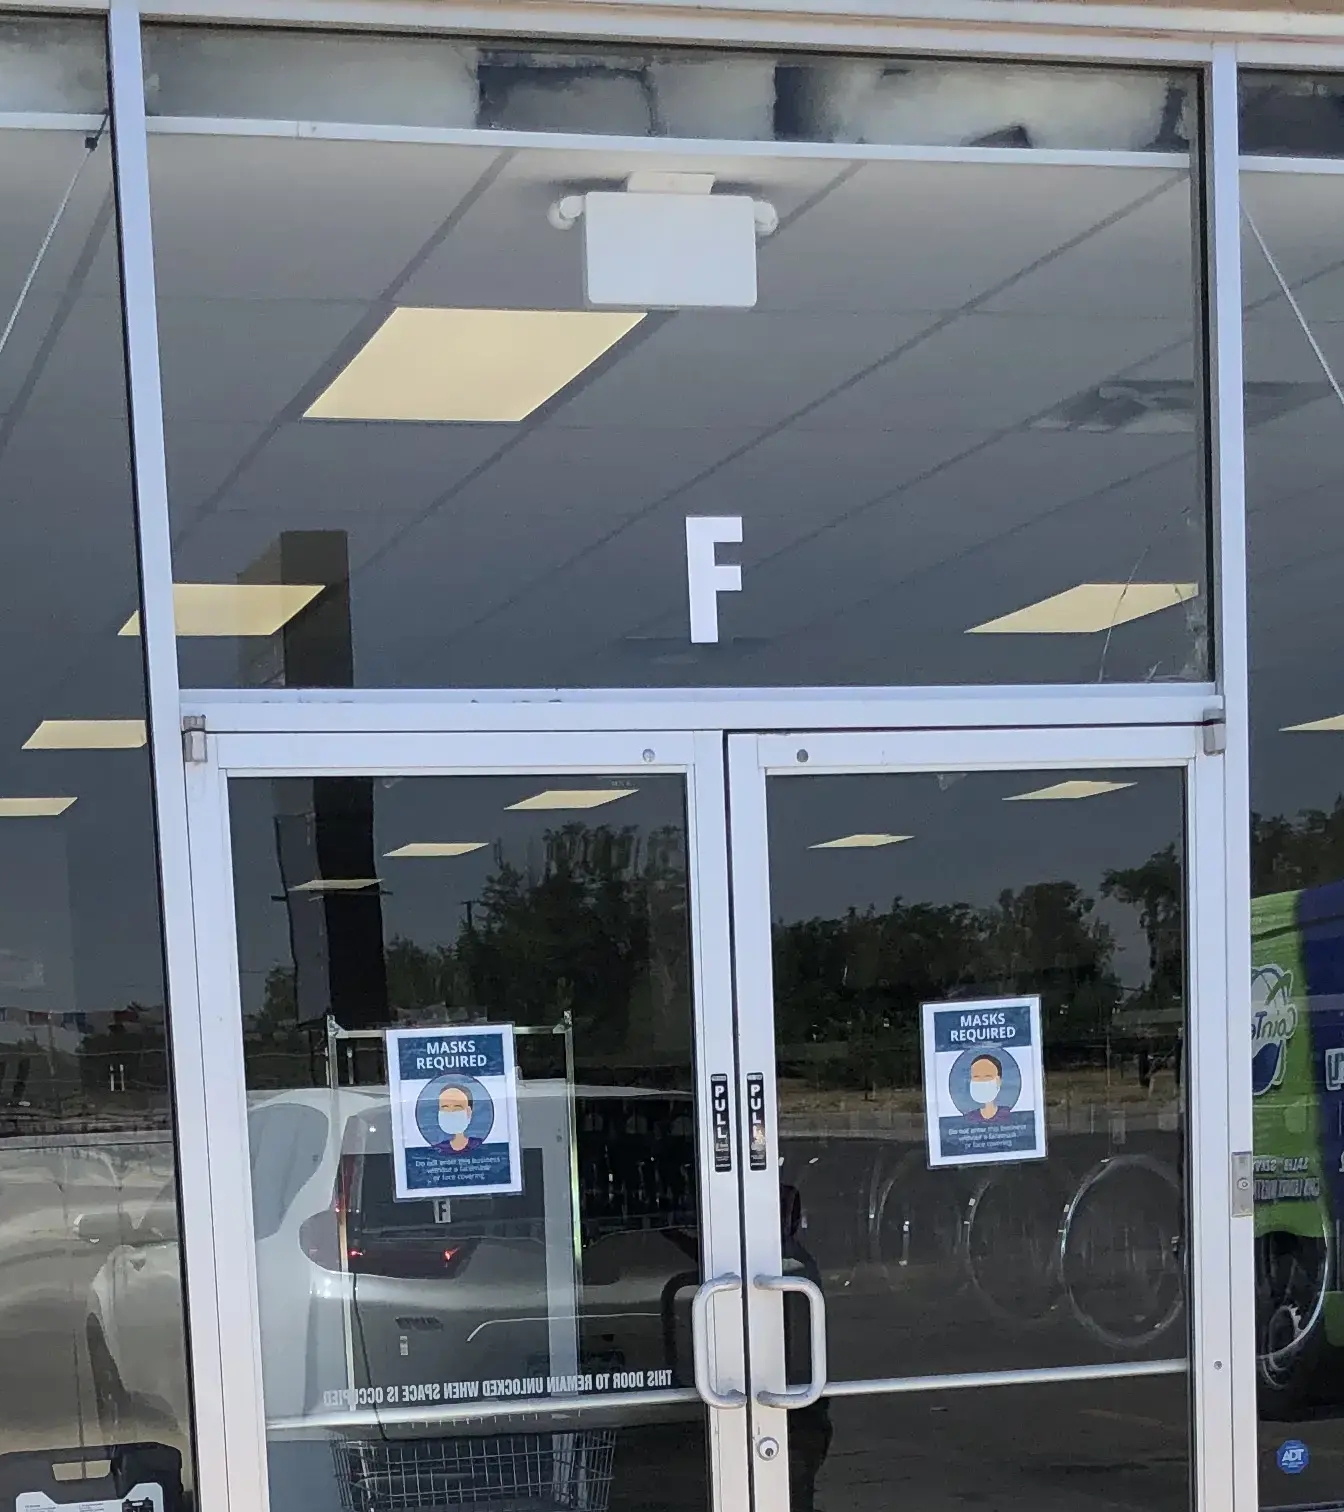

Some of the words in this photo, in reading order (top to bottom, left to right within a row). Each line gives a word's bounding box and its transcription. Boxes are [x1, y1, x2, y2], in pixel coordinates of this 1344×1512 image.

[685, 516, 743, 643] F
[960, 1013, 1006, 1027] MASKS
[950, 1026, 1016, 1042] REQUIRED
[426, 1040, 476, 1055] MASKS
[416, 1054, 487, 1070] REQUIRED
[714, 1085, 728, 1139] PULL
[750, 1084, 763, 1140] PULL
[1282, 1449, 1305, 1462] ADT
